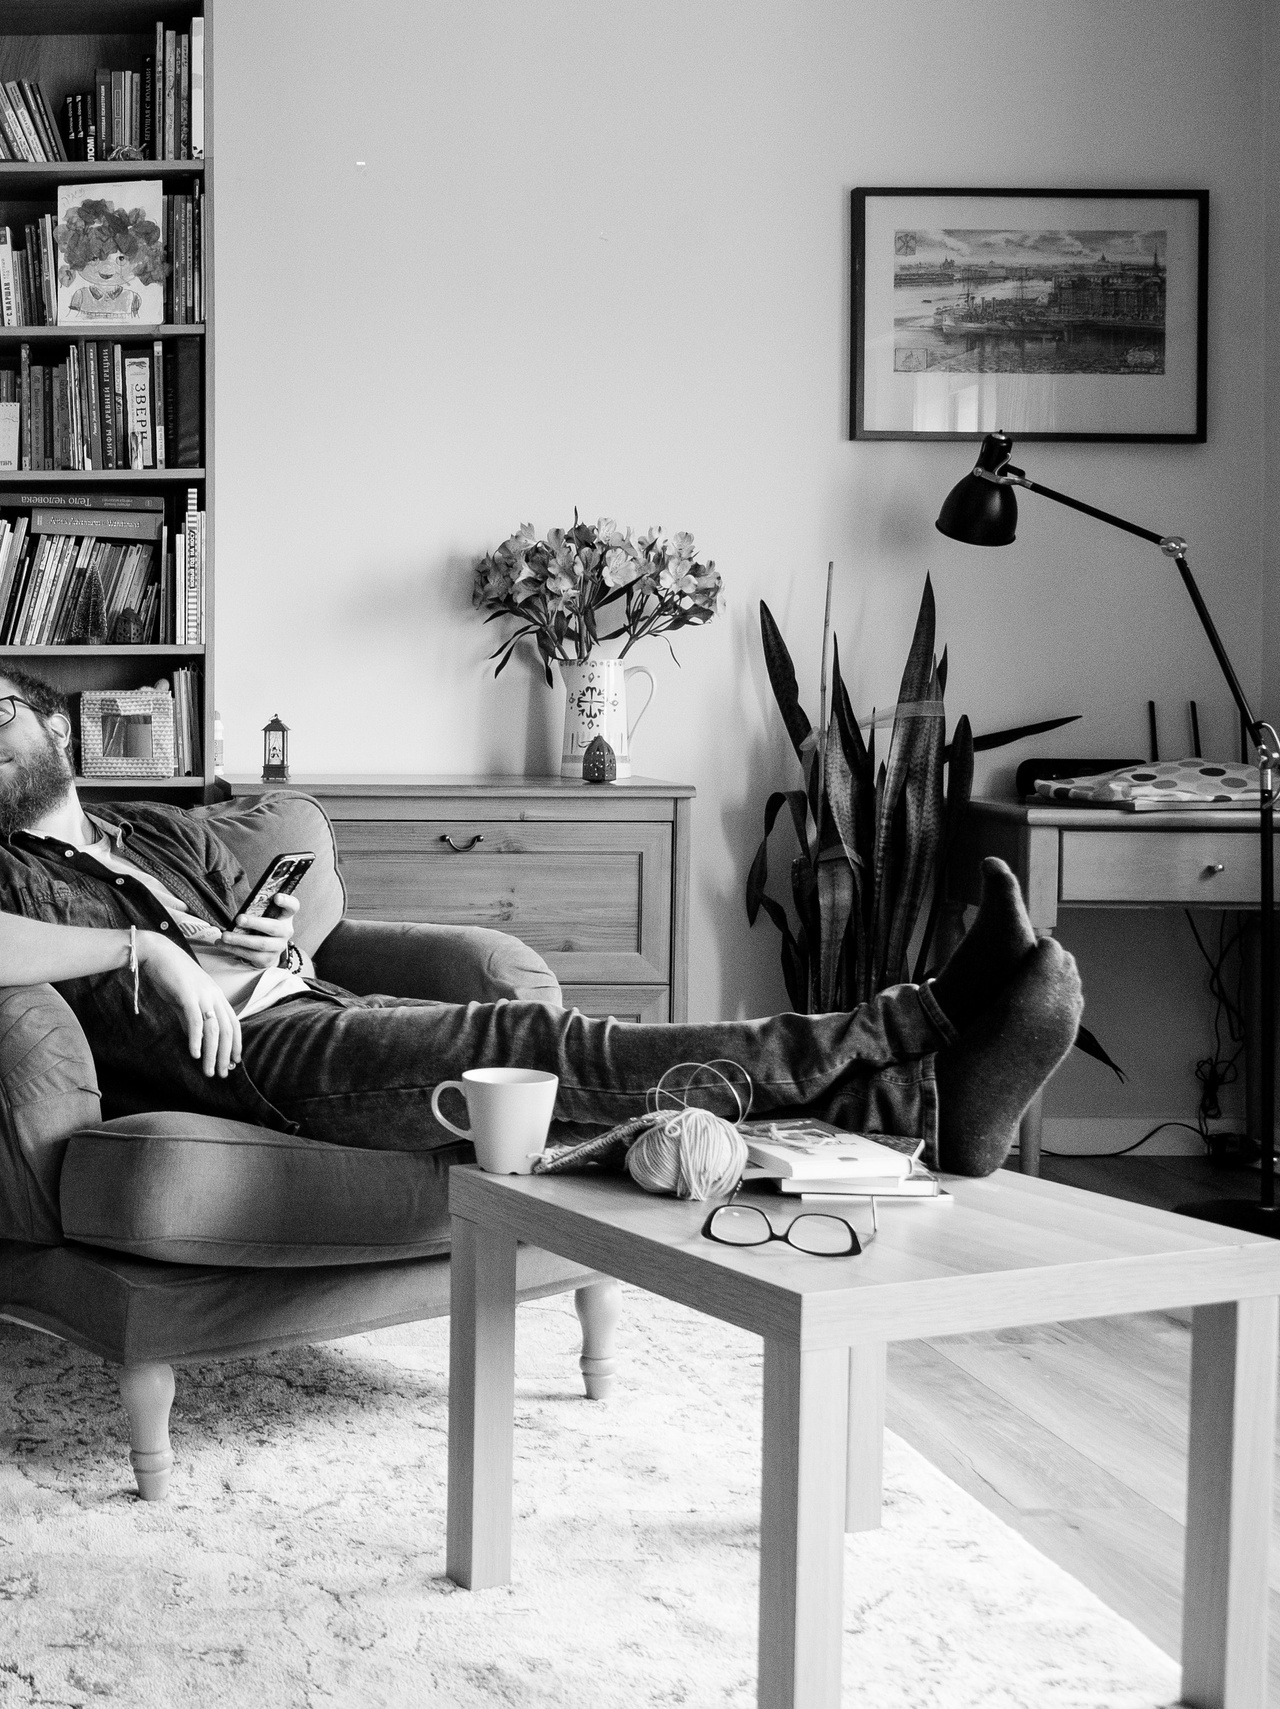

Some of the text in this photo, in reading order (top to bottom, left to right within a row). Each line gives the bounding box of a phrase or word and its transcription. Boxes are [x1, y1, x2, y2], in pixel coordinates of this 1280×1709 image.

[102, 348, 111, 382] ГРЕЦИИ
[104, 386, 112, 425] ДРЕВНЕЙ
[21, 495, 67, 505] человека
[68, 497, 91, 507] Тело
